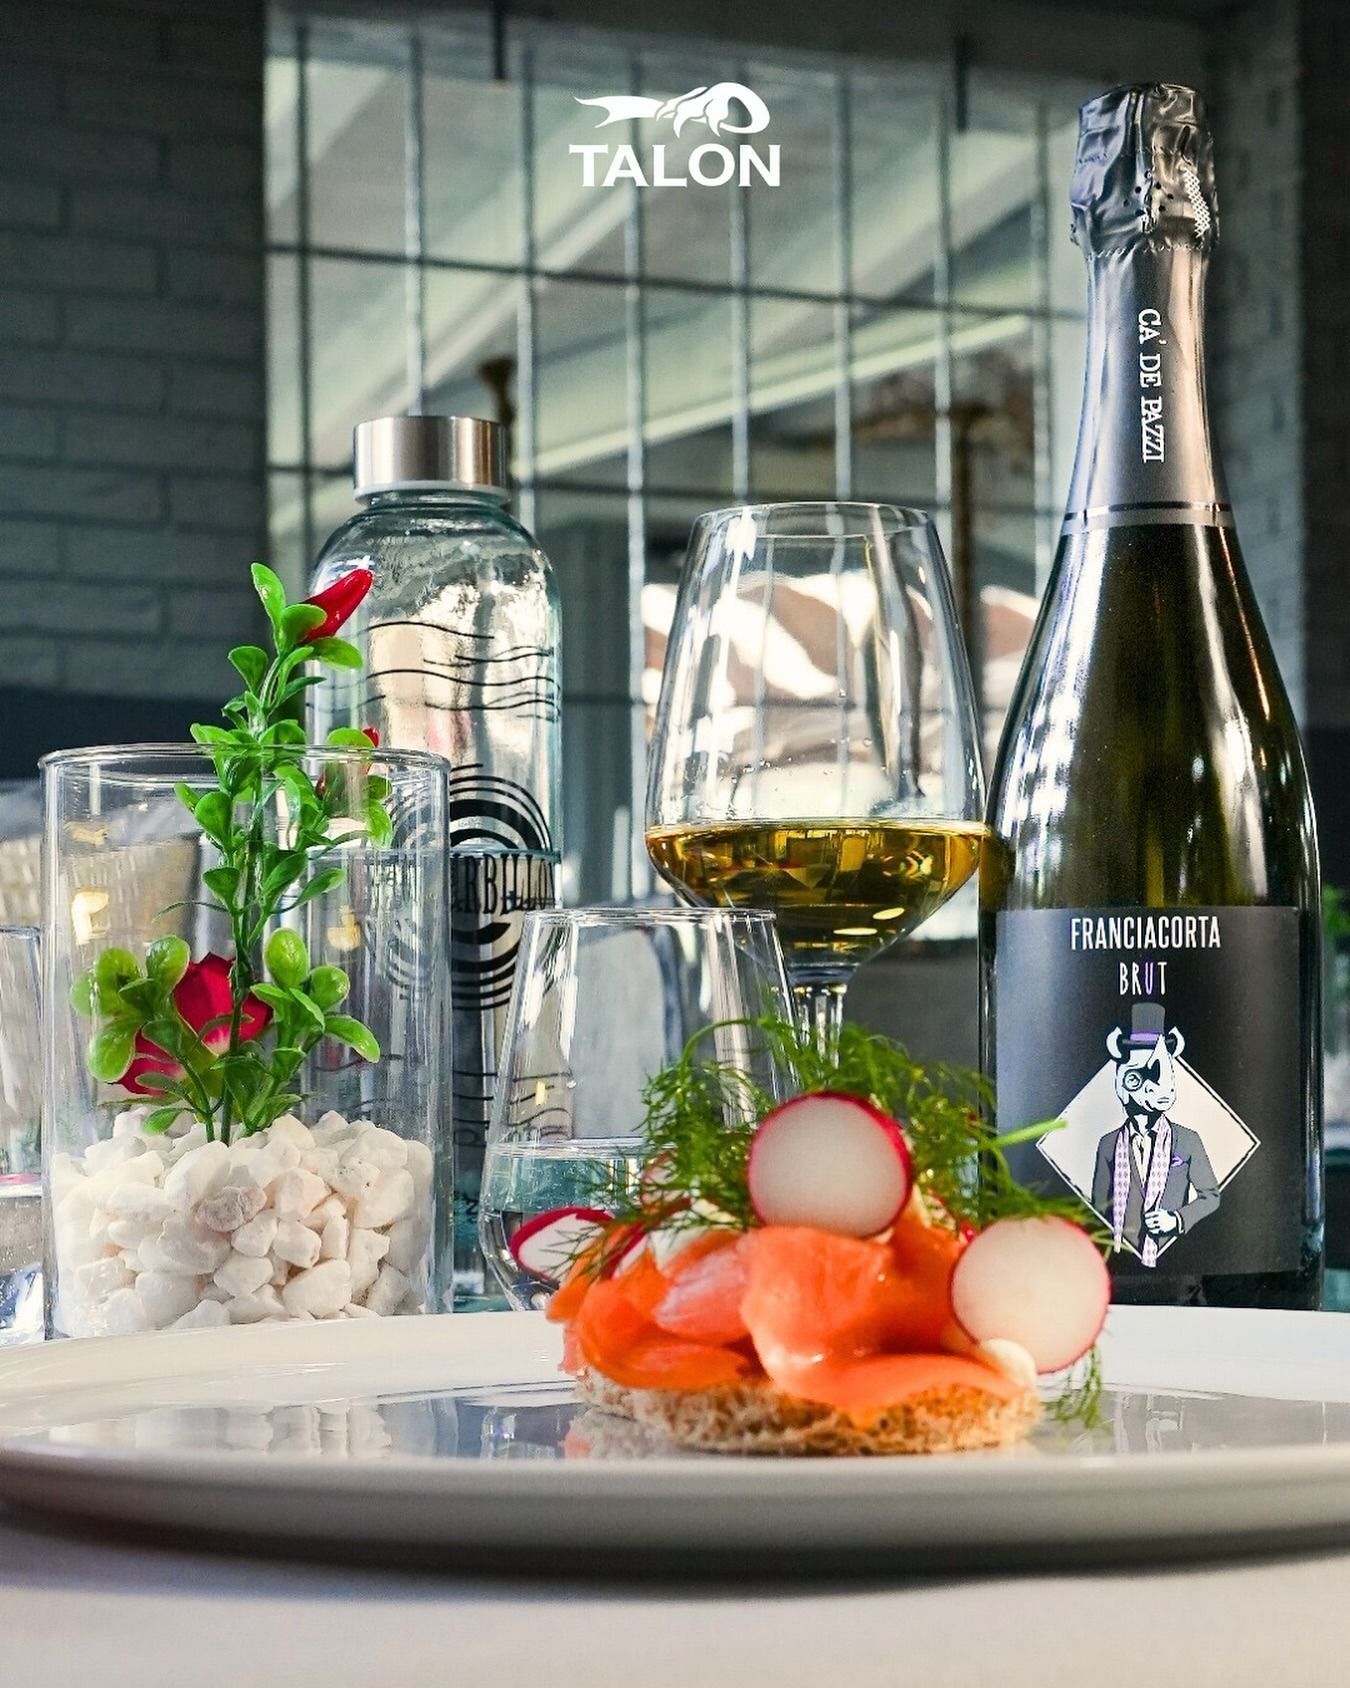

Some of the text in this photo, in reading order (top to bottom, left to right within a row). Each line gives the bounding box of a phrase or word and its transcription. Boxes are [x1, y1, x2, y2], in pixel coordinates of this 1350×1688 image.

[1139, 352, 1162, 389] DE
[1141, 396, 1165, 464] PAZZI
[1071, 915, 1222, 951] FRANCIACORTA
[1119, 961, 1168, 996] BRUT
